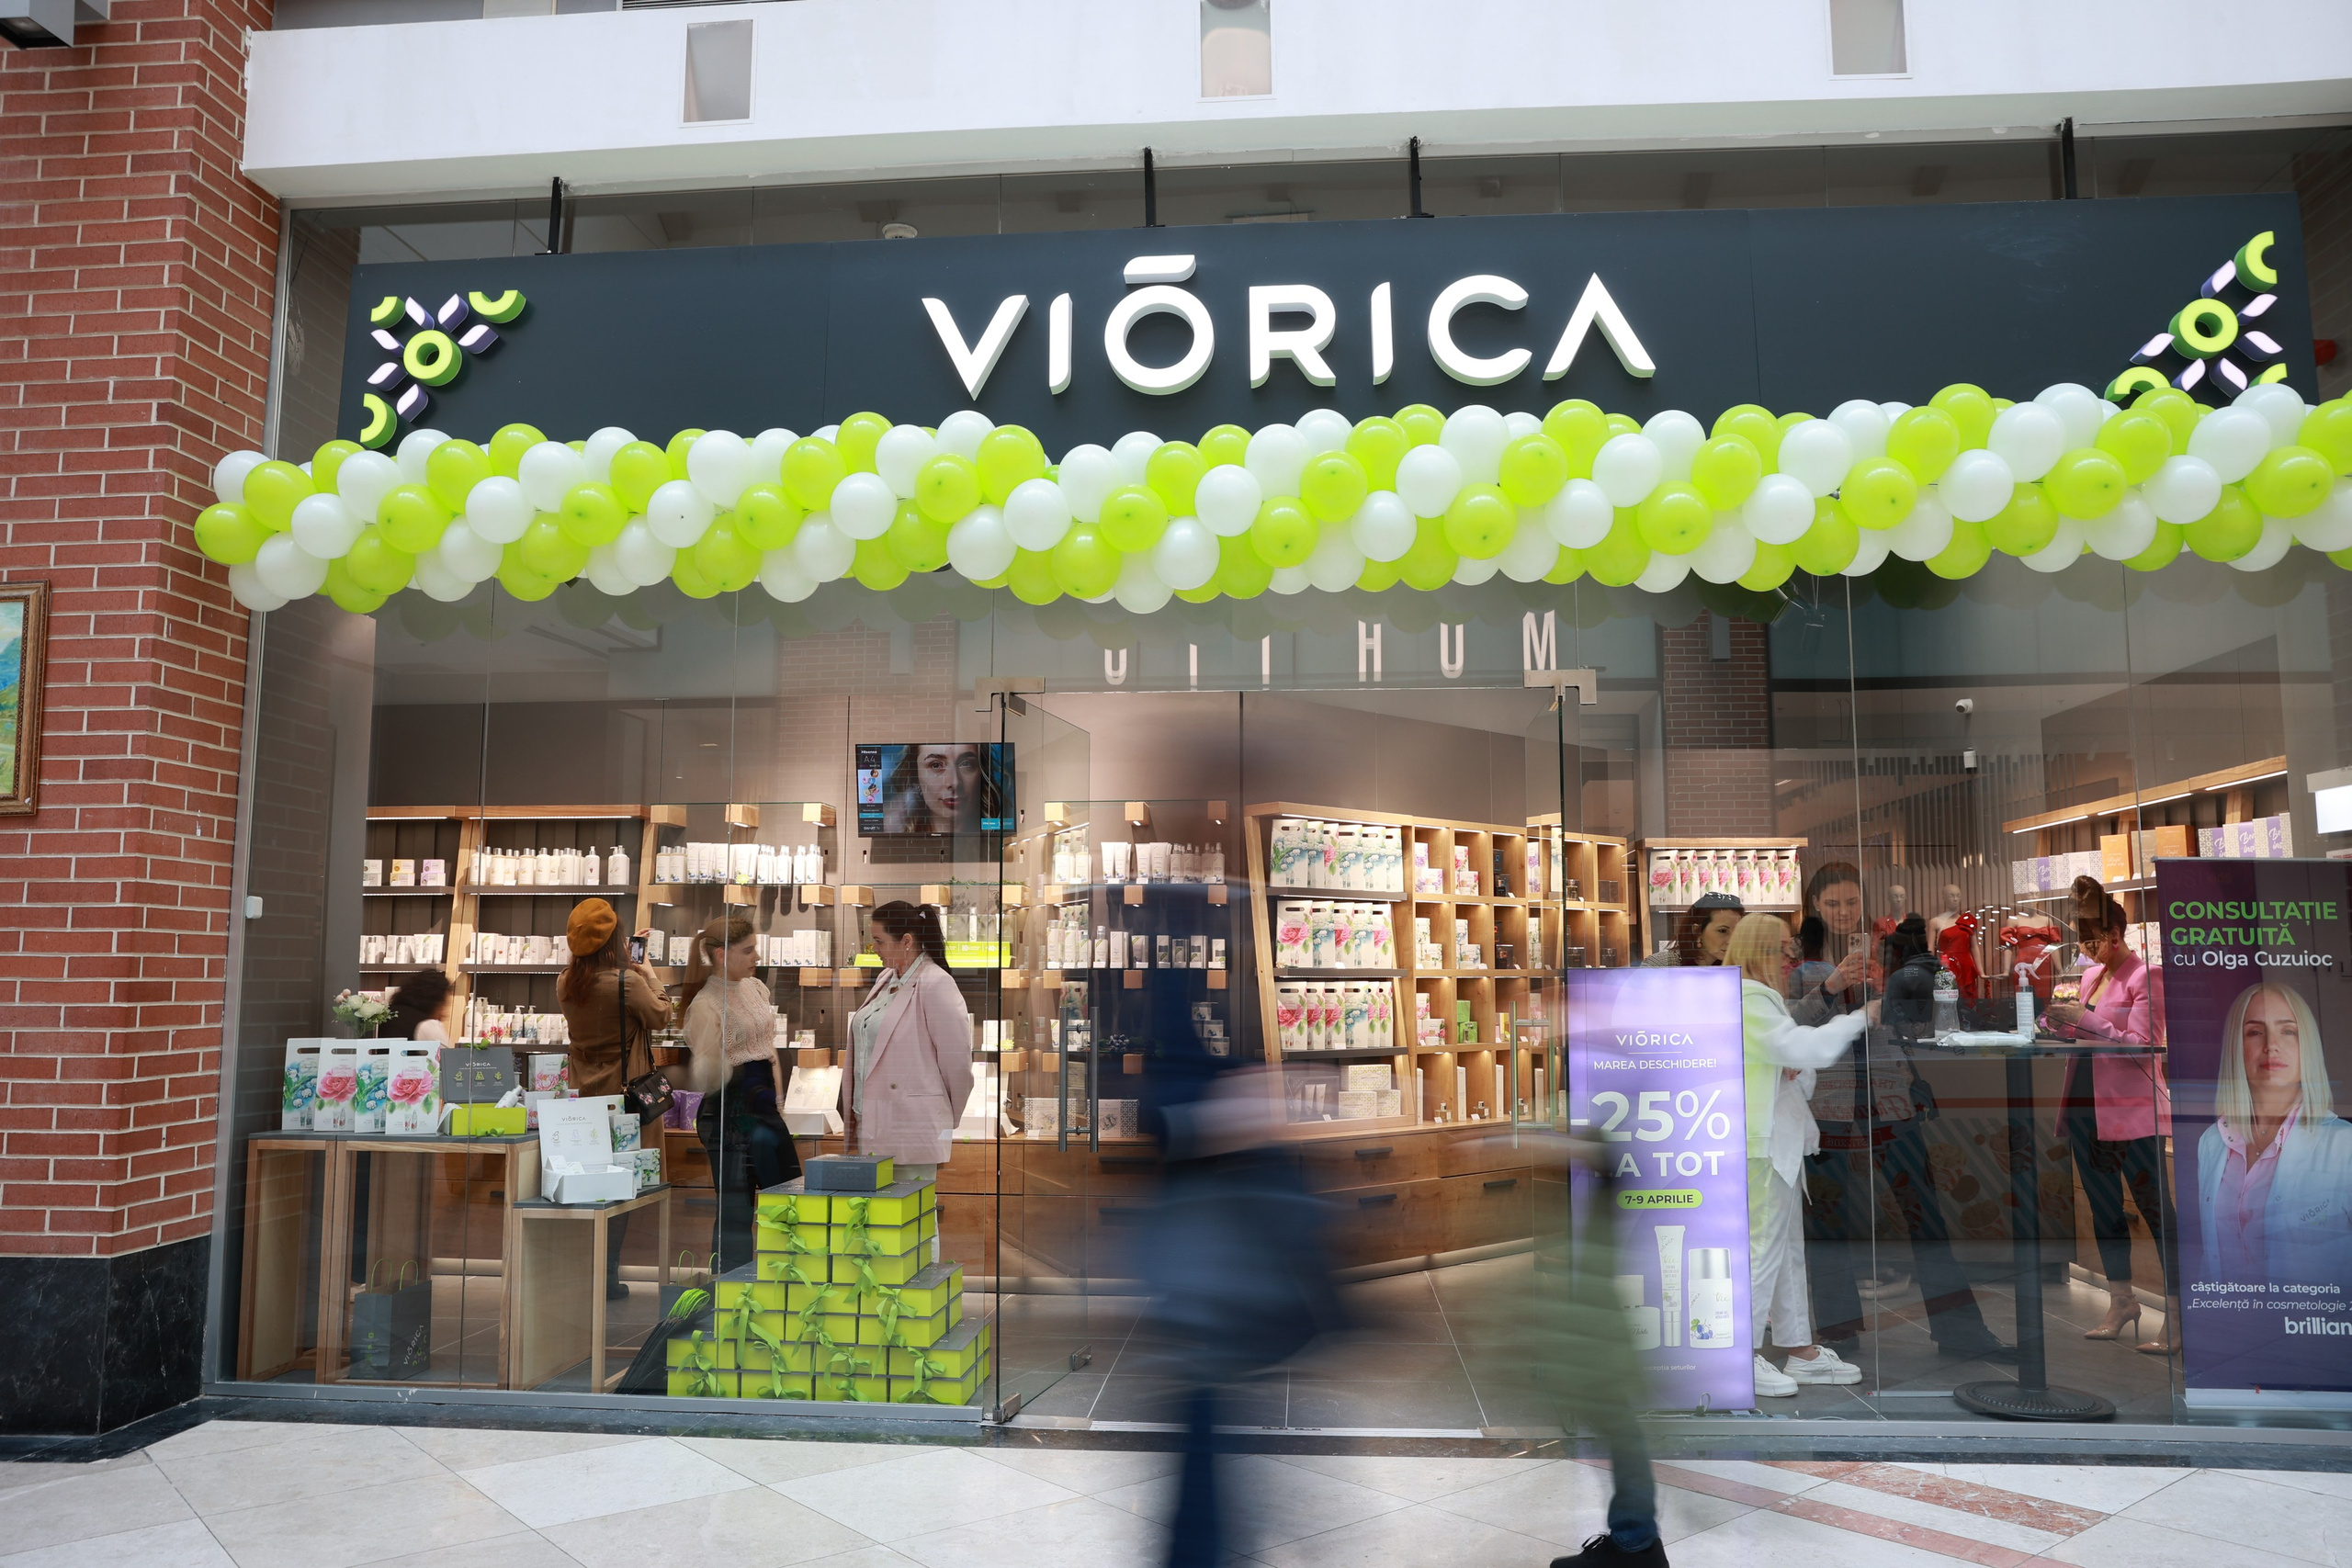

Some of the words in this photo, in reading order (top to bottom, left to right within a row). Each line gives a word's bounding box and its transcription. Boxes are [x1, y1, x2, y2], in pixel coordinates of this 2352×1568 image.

[2169, 901, 2338, 926] CONSULTAȚIE
[2170, 922, 2296, 945] GRATUITĂ
[2174, 954, 2196, 966] cu
[2201, 950, 2248, 970] Olga
[2254, 950, 2333, 966] Cuzuioc
[1593, 1060, 1636, 1070] MAREA
[1639, 1058, 1717, 1070] DESCHIDERE!
[1570, 1089, 1731, 1142] -25%
[1595, 1153, 1642, 1178] A
[1652, 1150, 1725, 1177] TOT
[1624, 1195, 1645, 1204] 7-9
[1646, 1194, 1694, 1204] APRILIE
[2190, 1281, 2266, 1294] câștigătoare
[2268, 1282, 2279, 1292] la
[2282, 1283, 2341, 1296] categoria
[2253, 1299, 2264, 1309] în
[2267, 1300, 2346, 1313] cosmetologie
